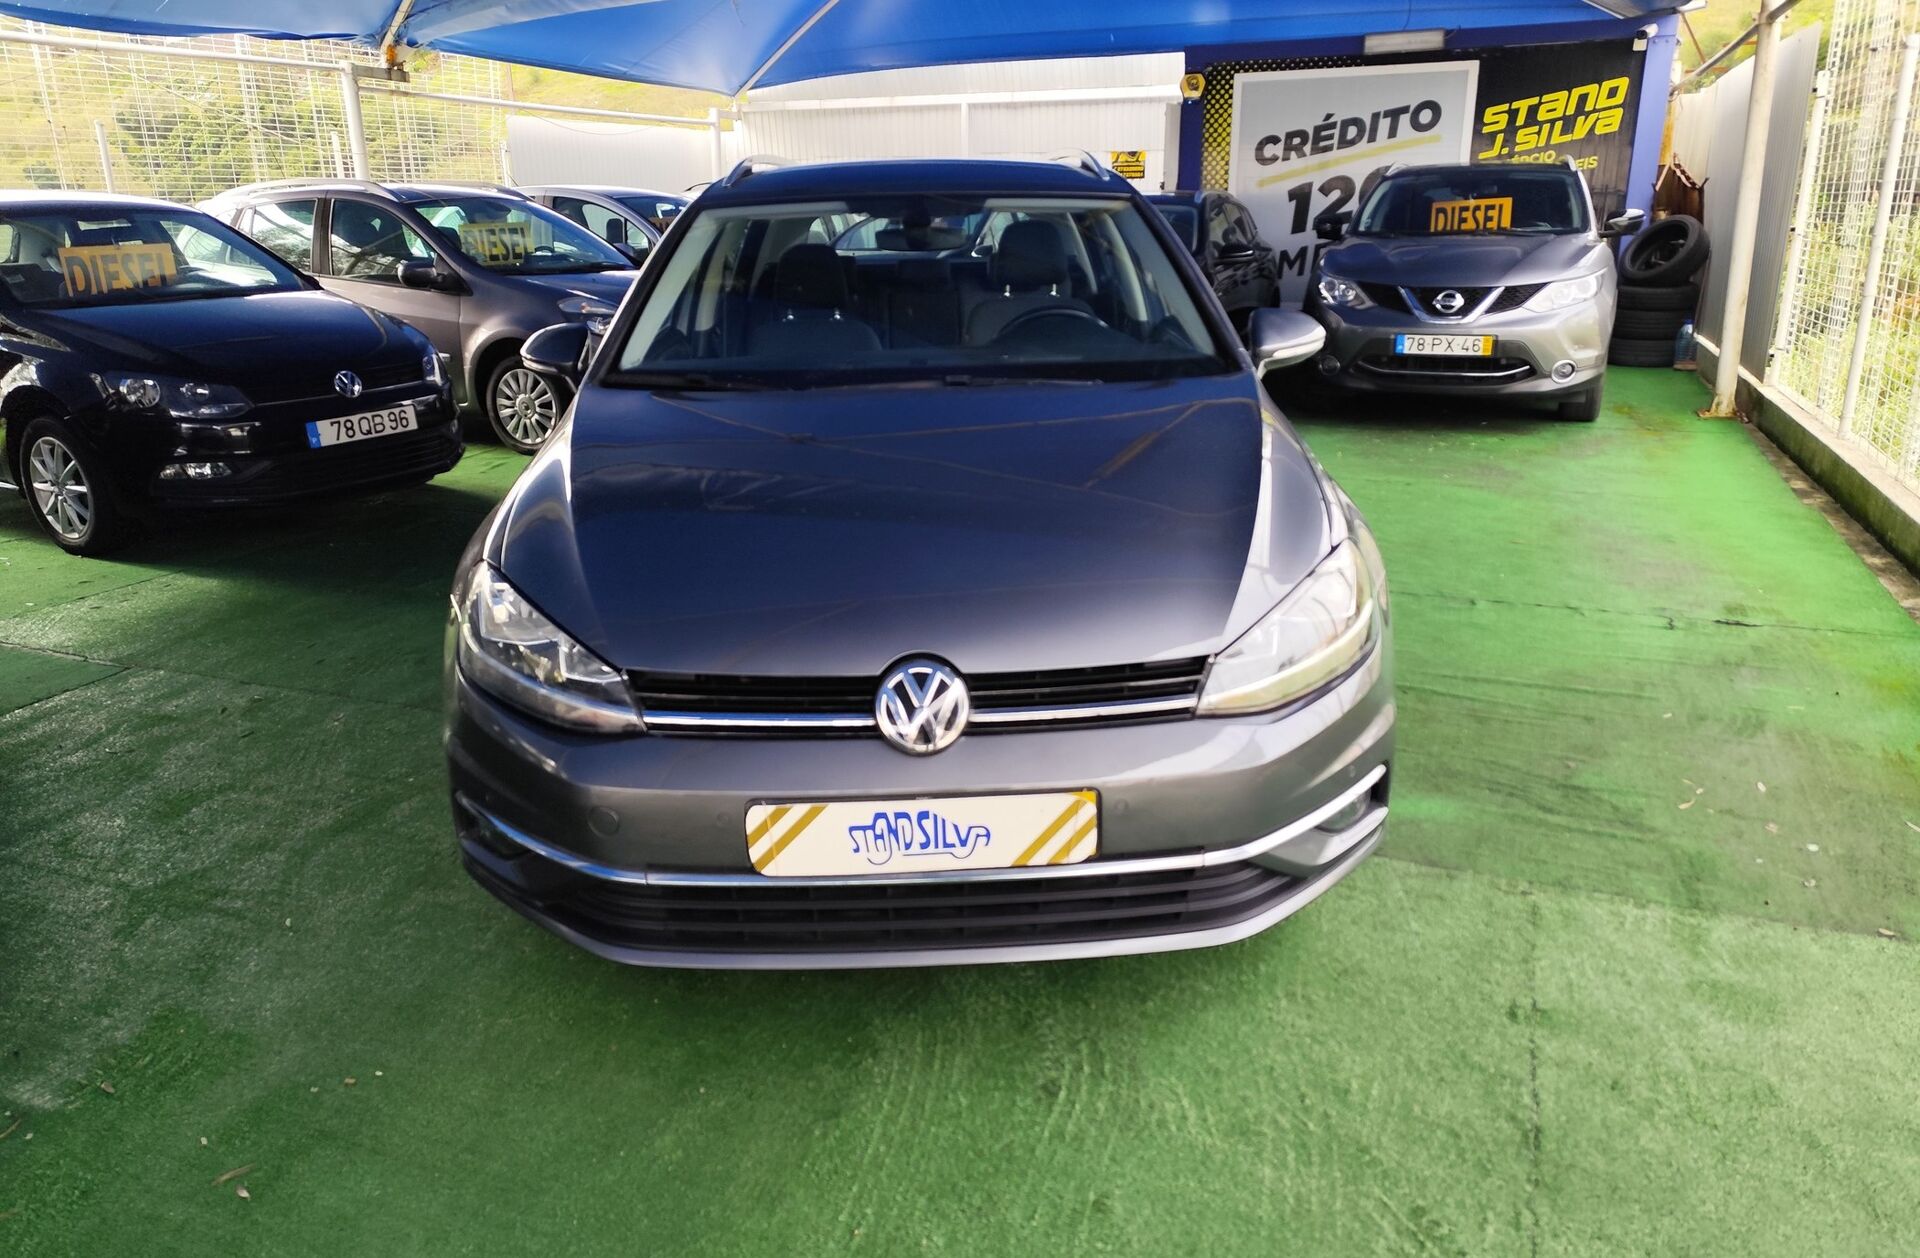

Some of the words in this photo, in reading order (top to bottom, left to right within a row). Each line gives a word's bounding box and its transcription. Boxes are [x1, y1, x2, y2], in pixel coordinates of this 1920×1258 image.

[1254, 99, 1442, 166] CRÉDITO
[1478, 133, 1510, 159] J.
[1435, 203, 1504, 231] DIESEL
